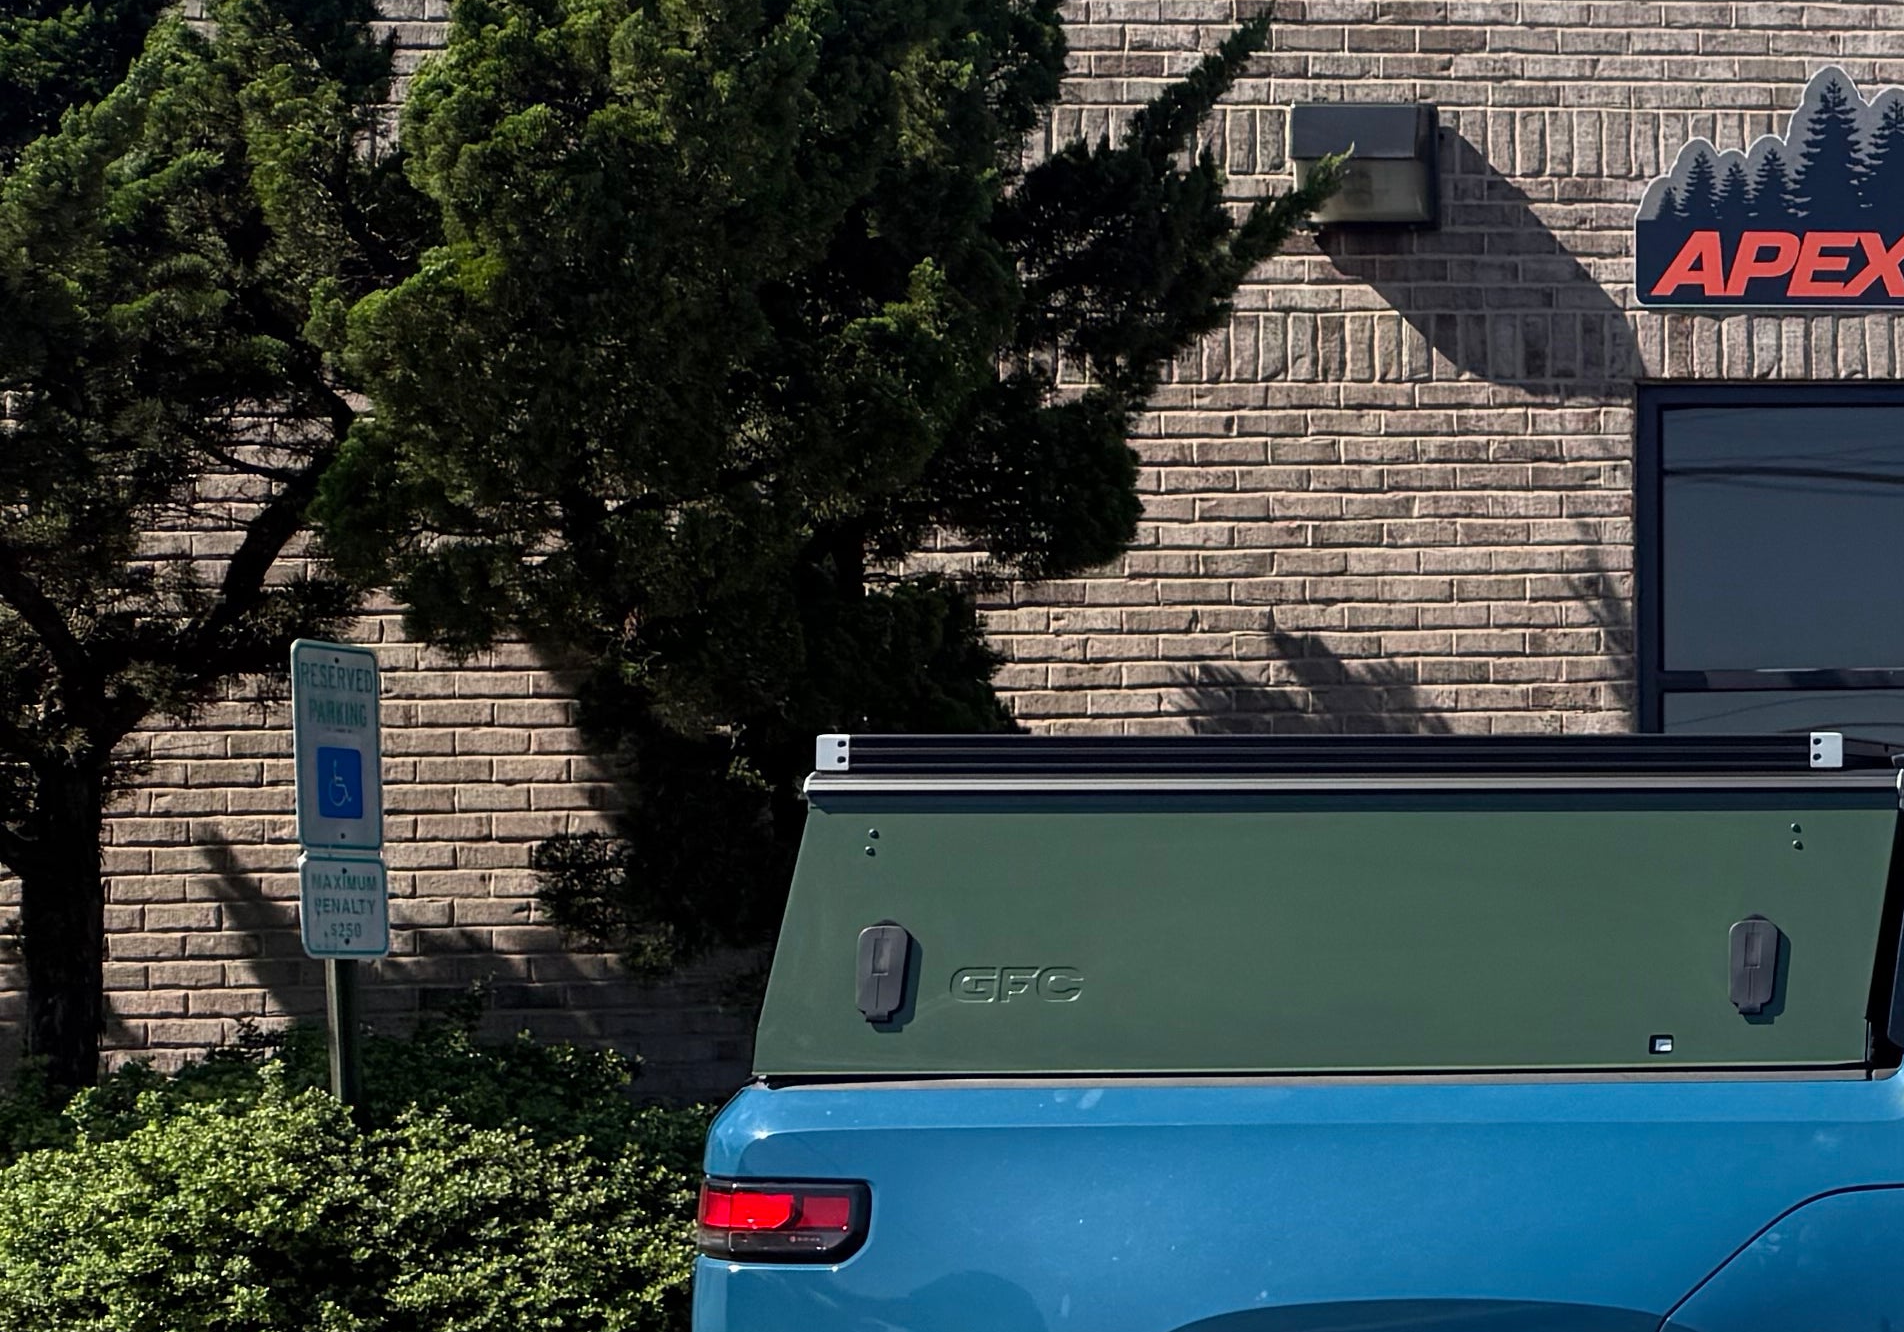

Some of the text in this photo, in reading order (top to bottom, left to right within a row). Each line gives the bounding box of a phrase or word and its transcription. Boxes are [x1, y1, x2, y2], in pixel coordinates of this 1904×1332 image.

[300, 662, 374, 693] RESERVED
[309, 698, 368, 727] PARKING
[311, 873, 377, 891] MAXIMUM
[315, 896, 376, 916] PENALTY
[950, 966, 1085, 1003] GFC
